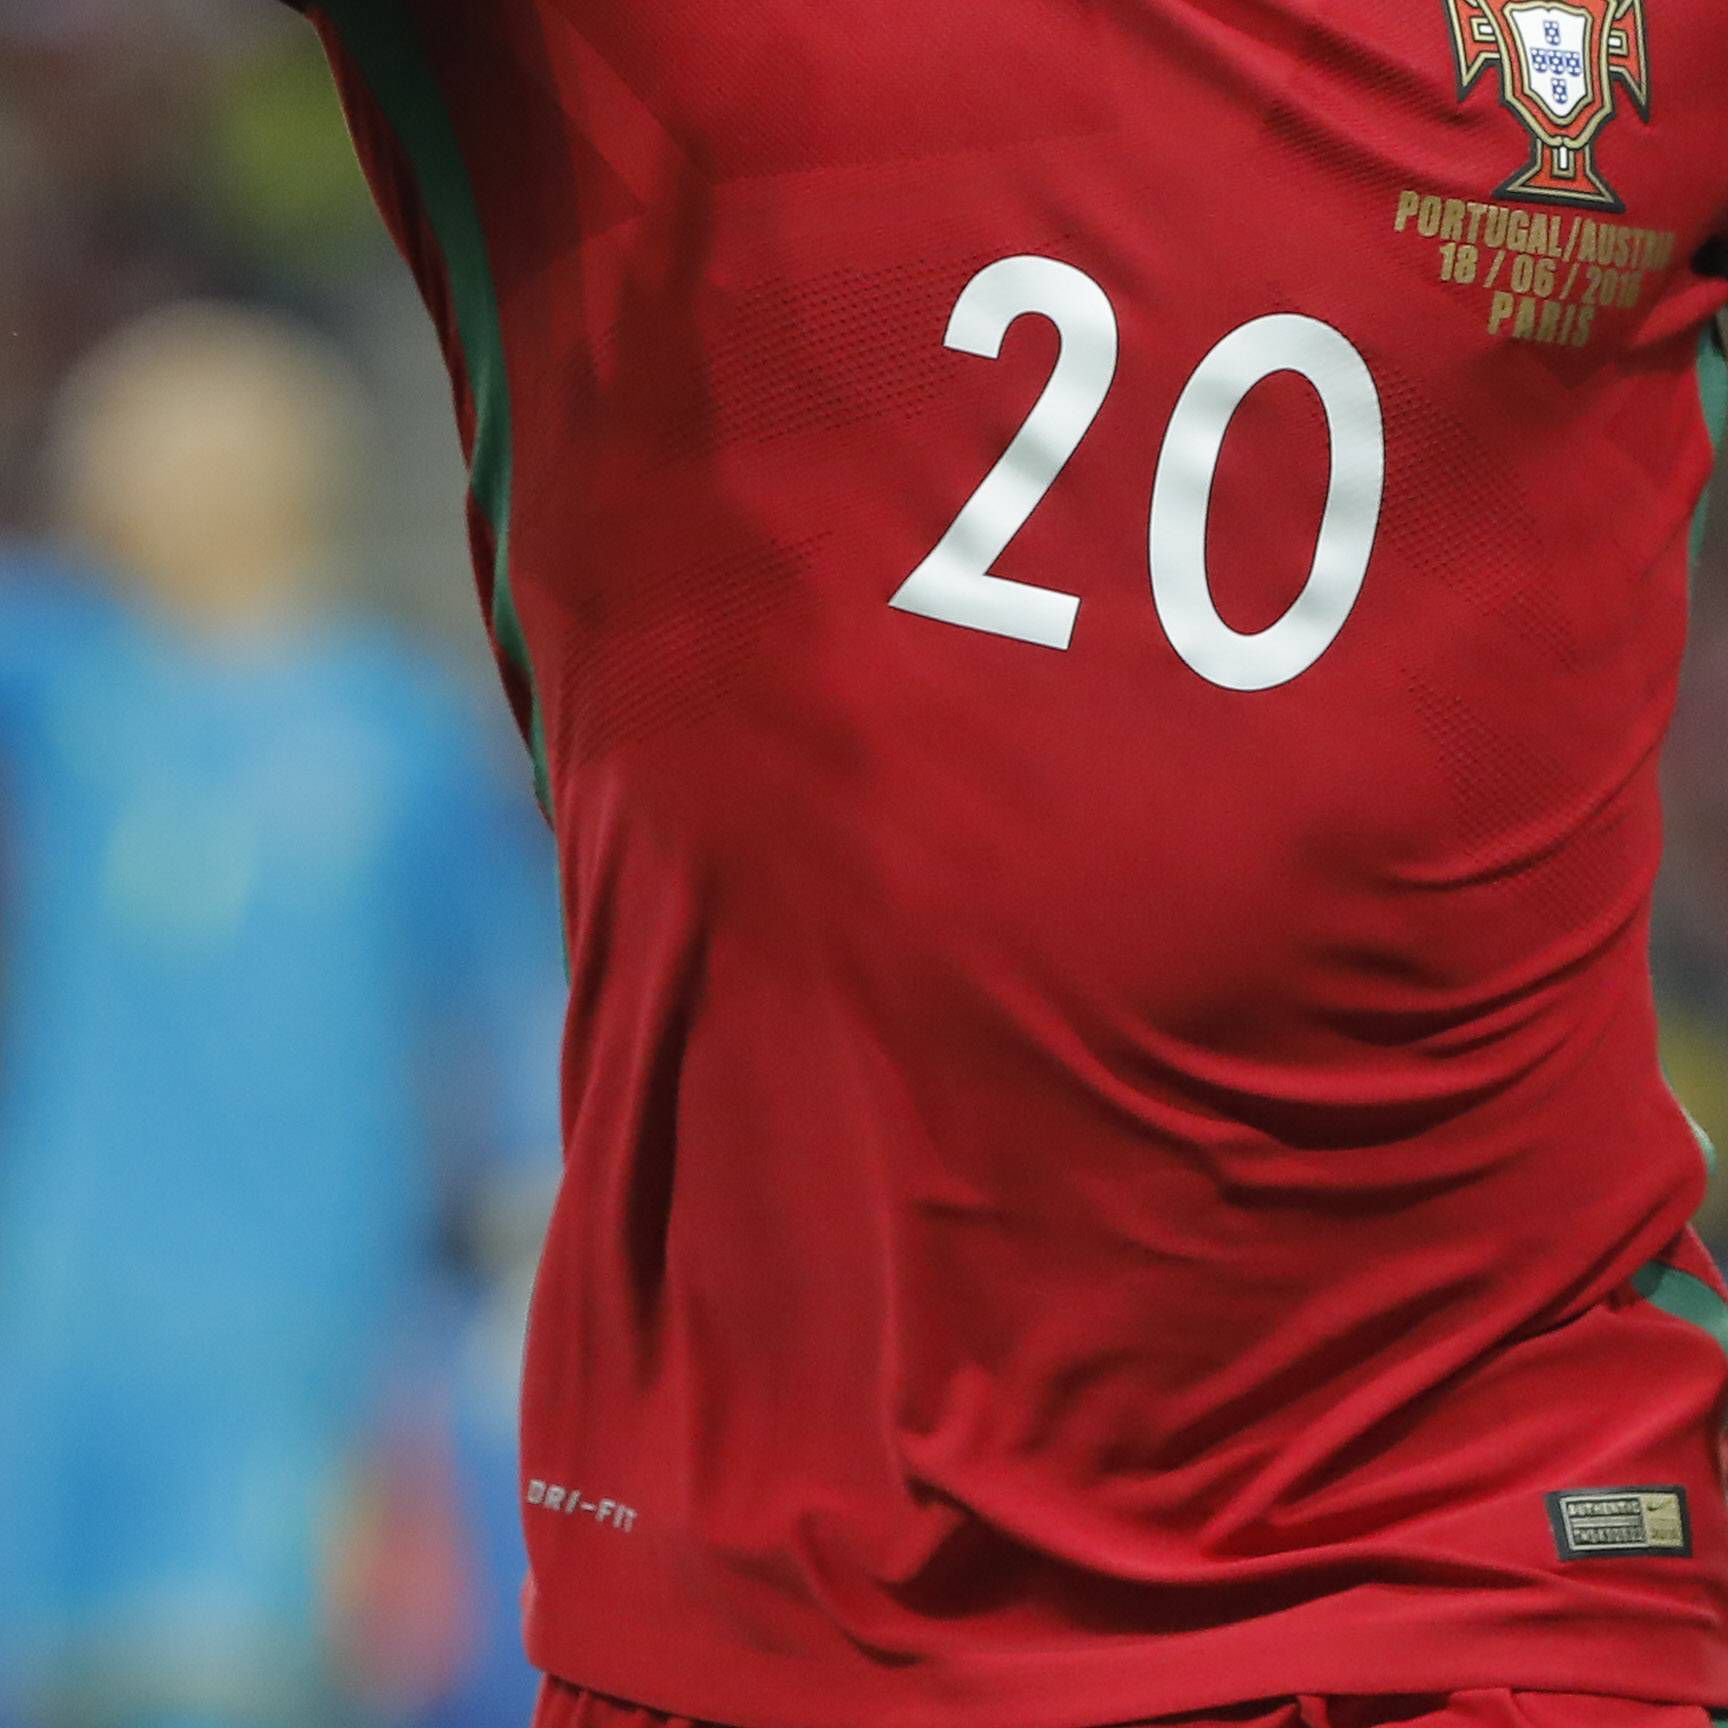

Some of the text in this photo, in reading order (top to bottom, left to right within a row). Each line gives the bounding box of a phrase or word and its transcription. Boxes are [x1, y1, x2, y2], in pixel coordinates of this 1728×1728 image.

[1439, 242, 1478, 284] 18
[1511, 254, 1557, 298] 06
[1487, 290, 1595, 348] PARIS
[888, 253, 1385, 691] 20
[527, 1478, 638, 1533] DRI-FIT
